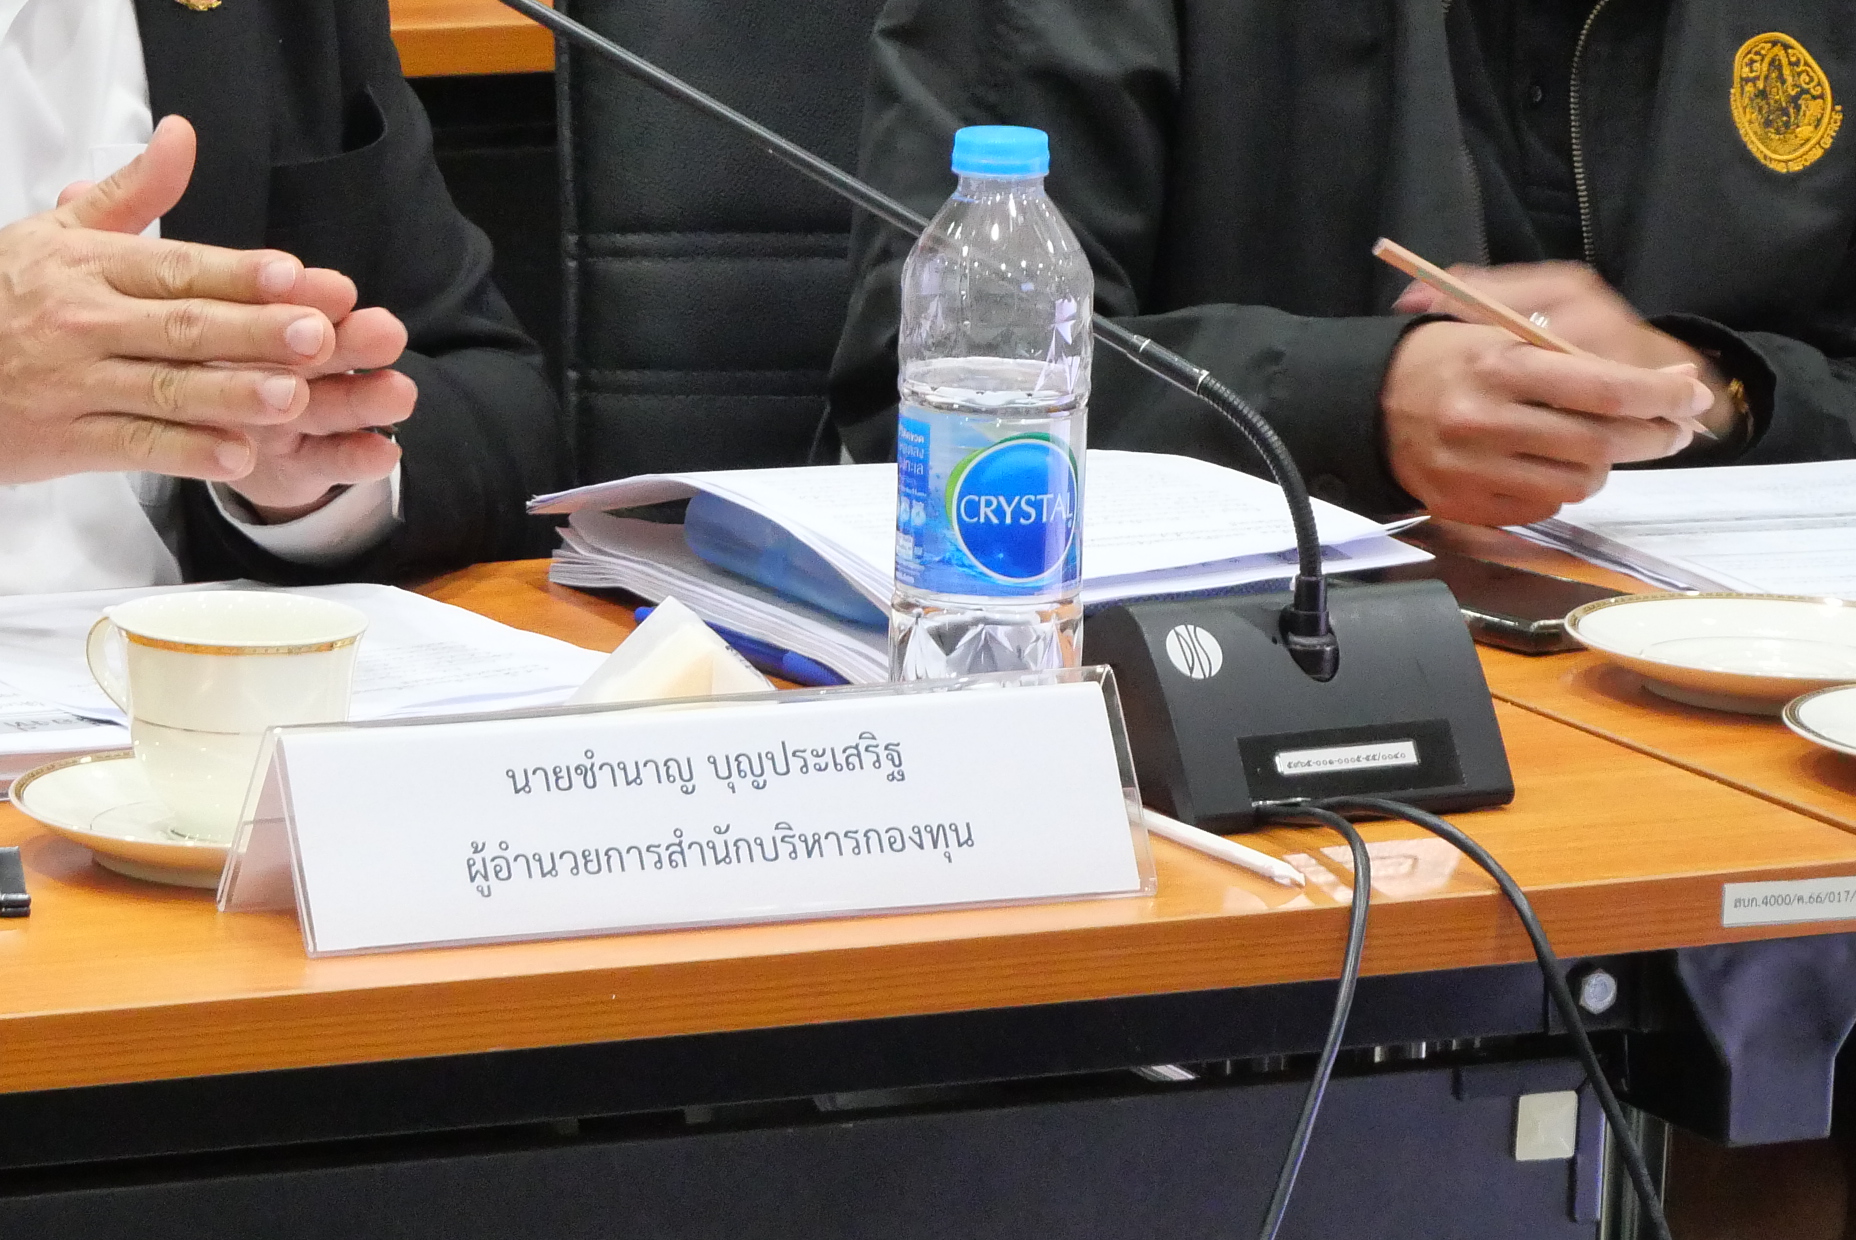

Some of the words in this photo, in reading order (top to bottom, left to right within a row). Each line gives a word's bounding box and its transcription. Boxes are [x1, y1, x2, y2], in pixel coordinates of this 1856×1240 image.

[505, 749, 696, 796] นายชำนาญ
[707, 730, 906, 794] บุญประเสริฐ
[465, 820, 975, 898] ผู้อำนวยการสำนักบริหารกองทุน
